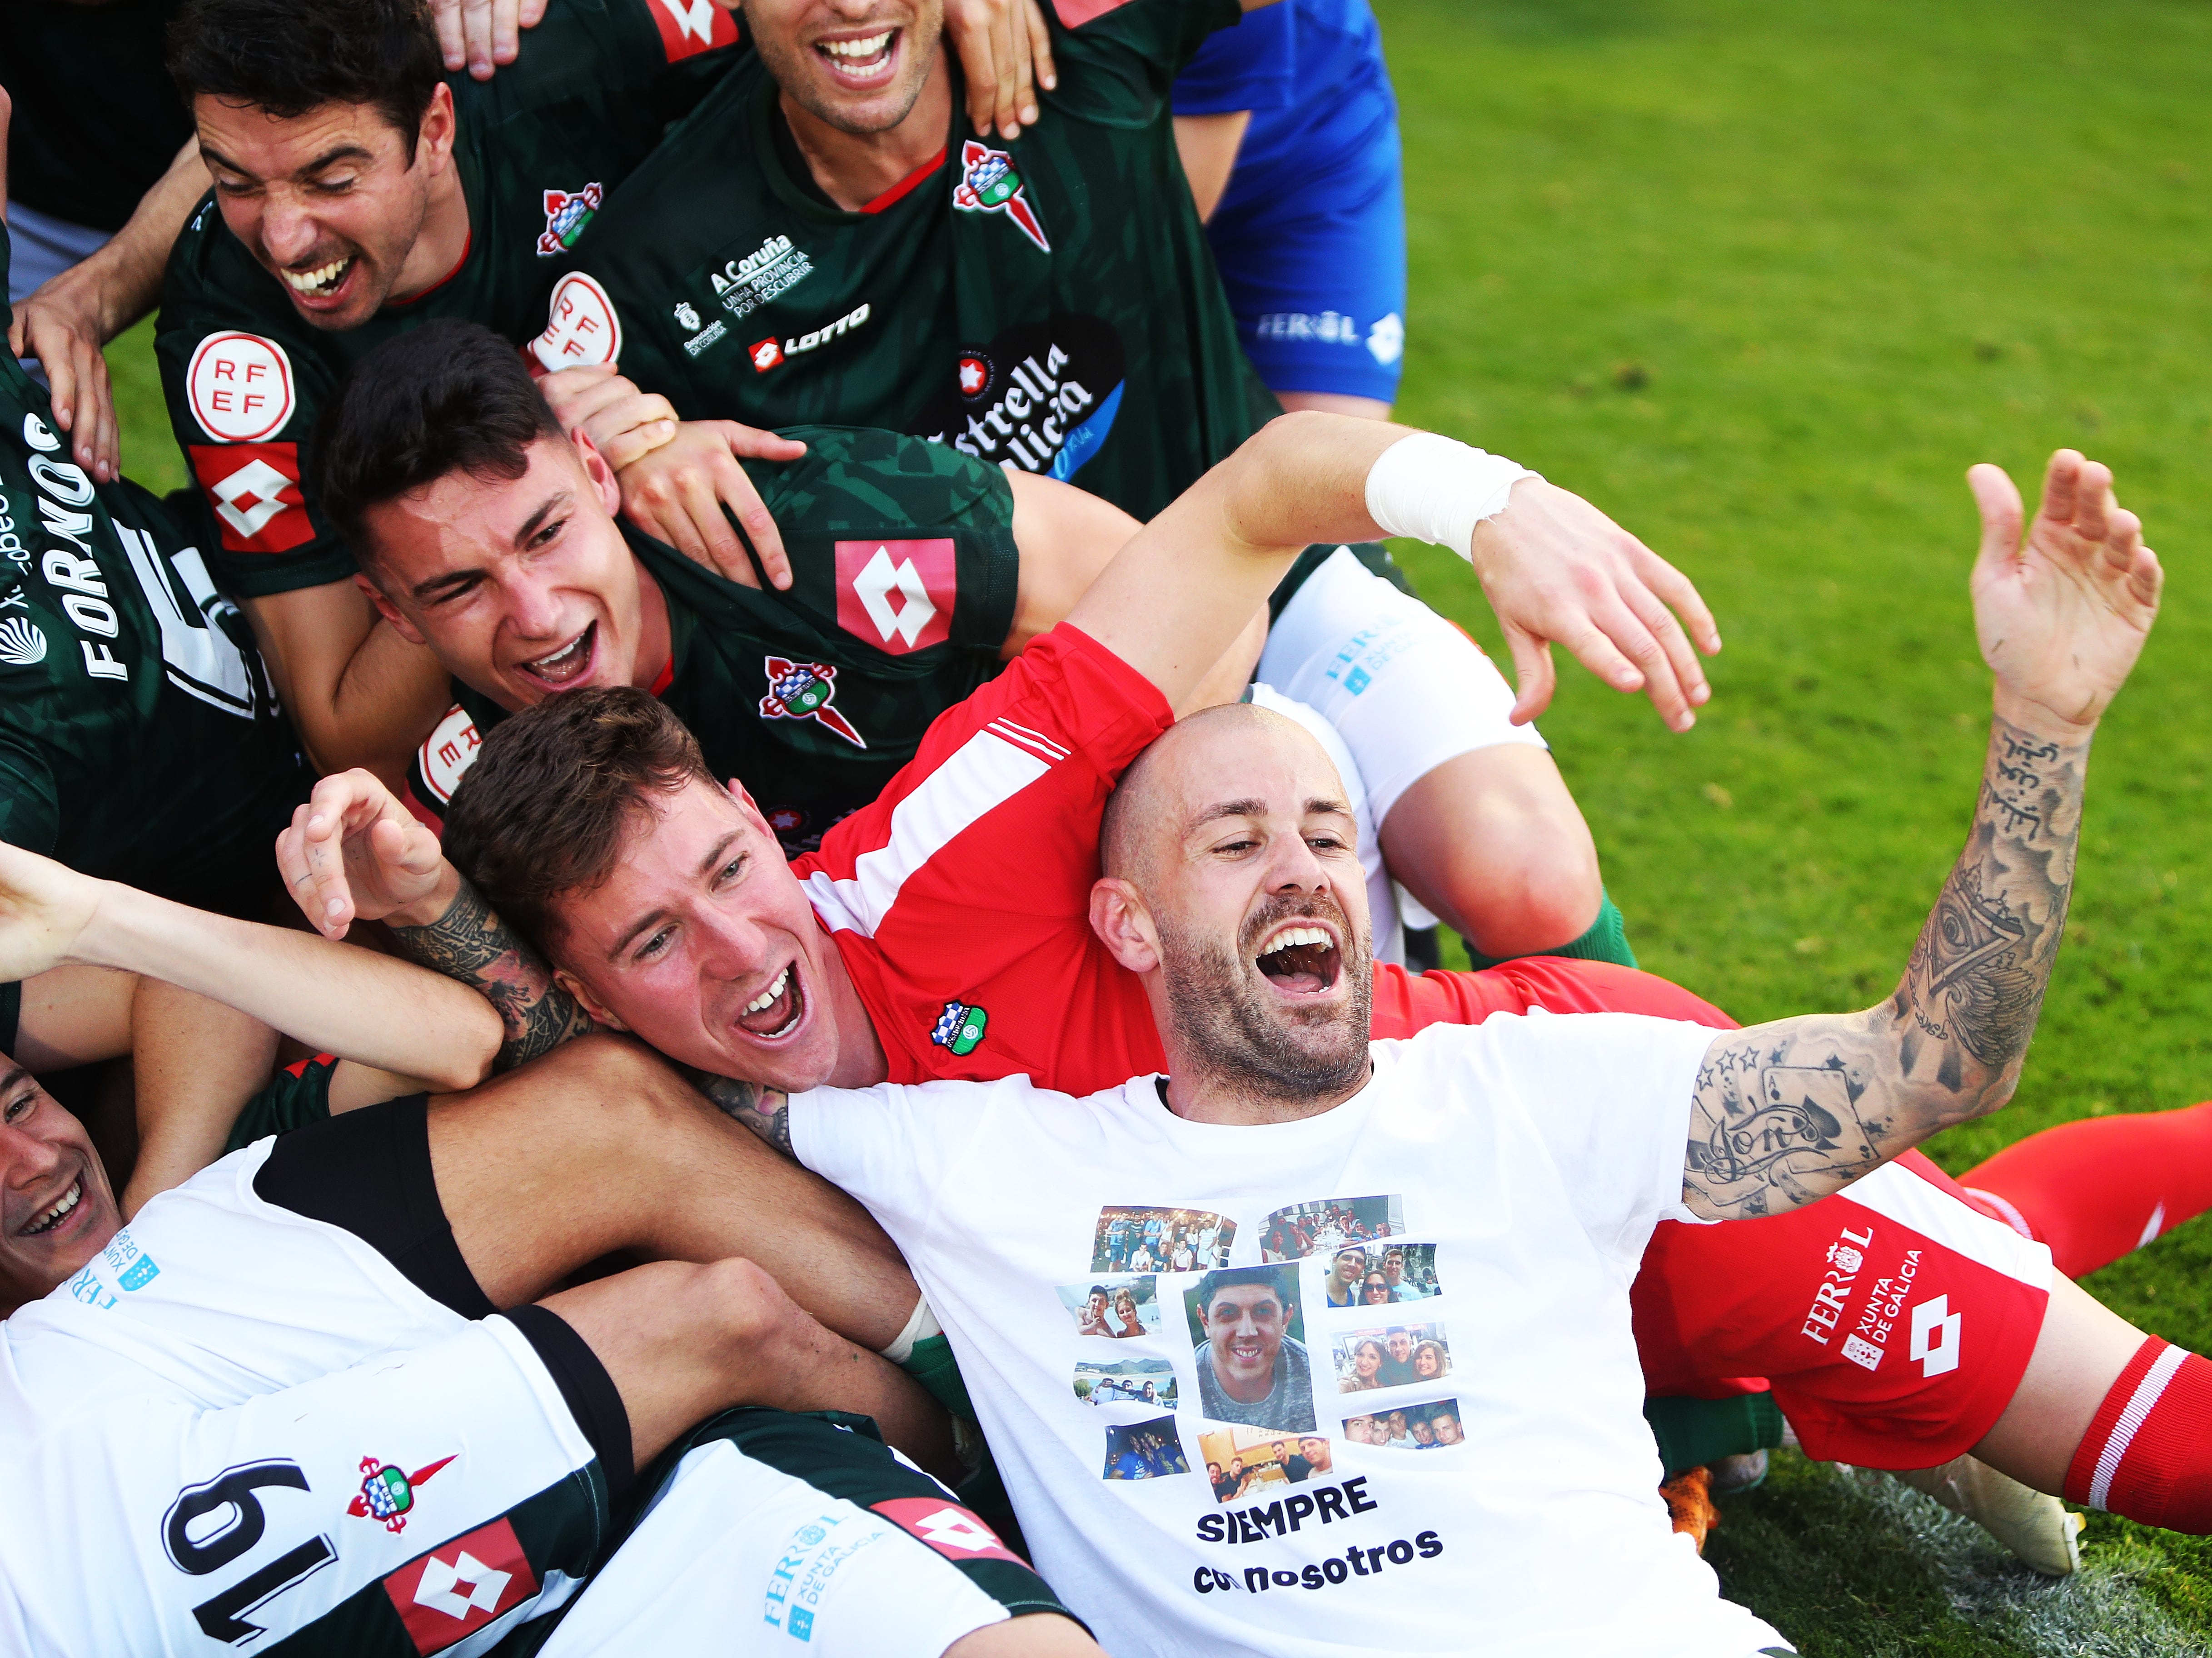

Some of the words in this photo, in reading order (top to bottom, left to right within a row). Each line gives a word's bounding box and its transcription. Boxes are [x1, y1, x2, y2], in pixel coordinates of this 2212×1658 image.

[710, 273, 731, 295] A
[725, 235, 794, 281] Coruña
[721, 286, 755, 312] UNHA
[750, 251, 810, 292] PROVINCIA
[733, 298, 759, 320] POR
[755, 261, 815, 304] DESCUBRIR
[784, 302, 872, 356] LOTTO
[927, 342, 1069, 457] strella
[999, 380, 1093, 471] licia
[1800, 1226, 1874, 1346] FERROL
[1856, 1278, 1894, 1335] XUNTA
[1872, 1318, 1893, 1343] DE
[1884, 1249, 1923, 1318] GALICIA
[1196, 1476, 1378, 1544] SIEMPRE
[161, 1458, 339, 1648] 19
[763, 1514, 849, 1630] FERROL
[797, 1546, 842, 1599] XUNTA
[806, 1579, 825, 1605] DE
[822, 1532, 884, 1578] GALICIA
[1244, 1530, 1444, 1594] nosotros
